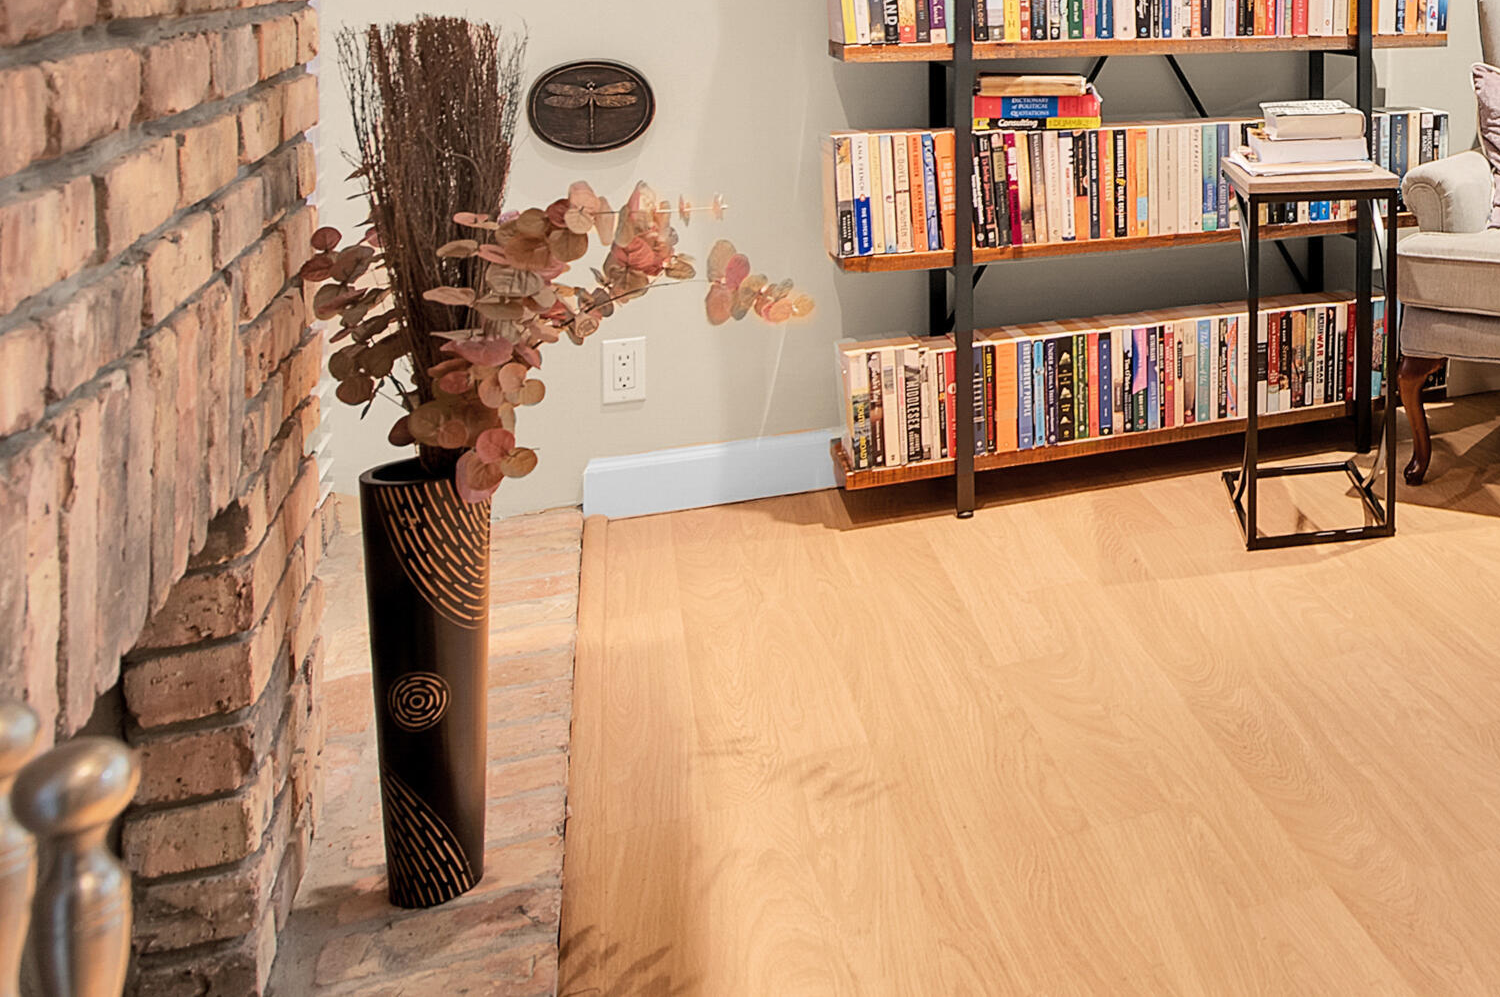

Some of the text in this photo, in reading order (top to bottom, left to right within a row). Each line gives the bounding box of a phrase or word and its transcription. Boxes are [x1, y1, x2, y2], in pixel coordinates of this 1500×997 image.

[998, 119, 1038, 128] Consulting
[1023, 344, 1031, 389] INDEPENDENT
[906, 381, 919, 430] MIDDLESEX
